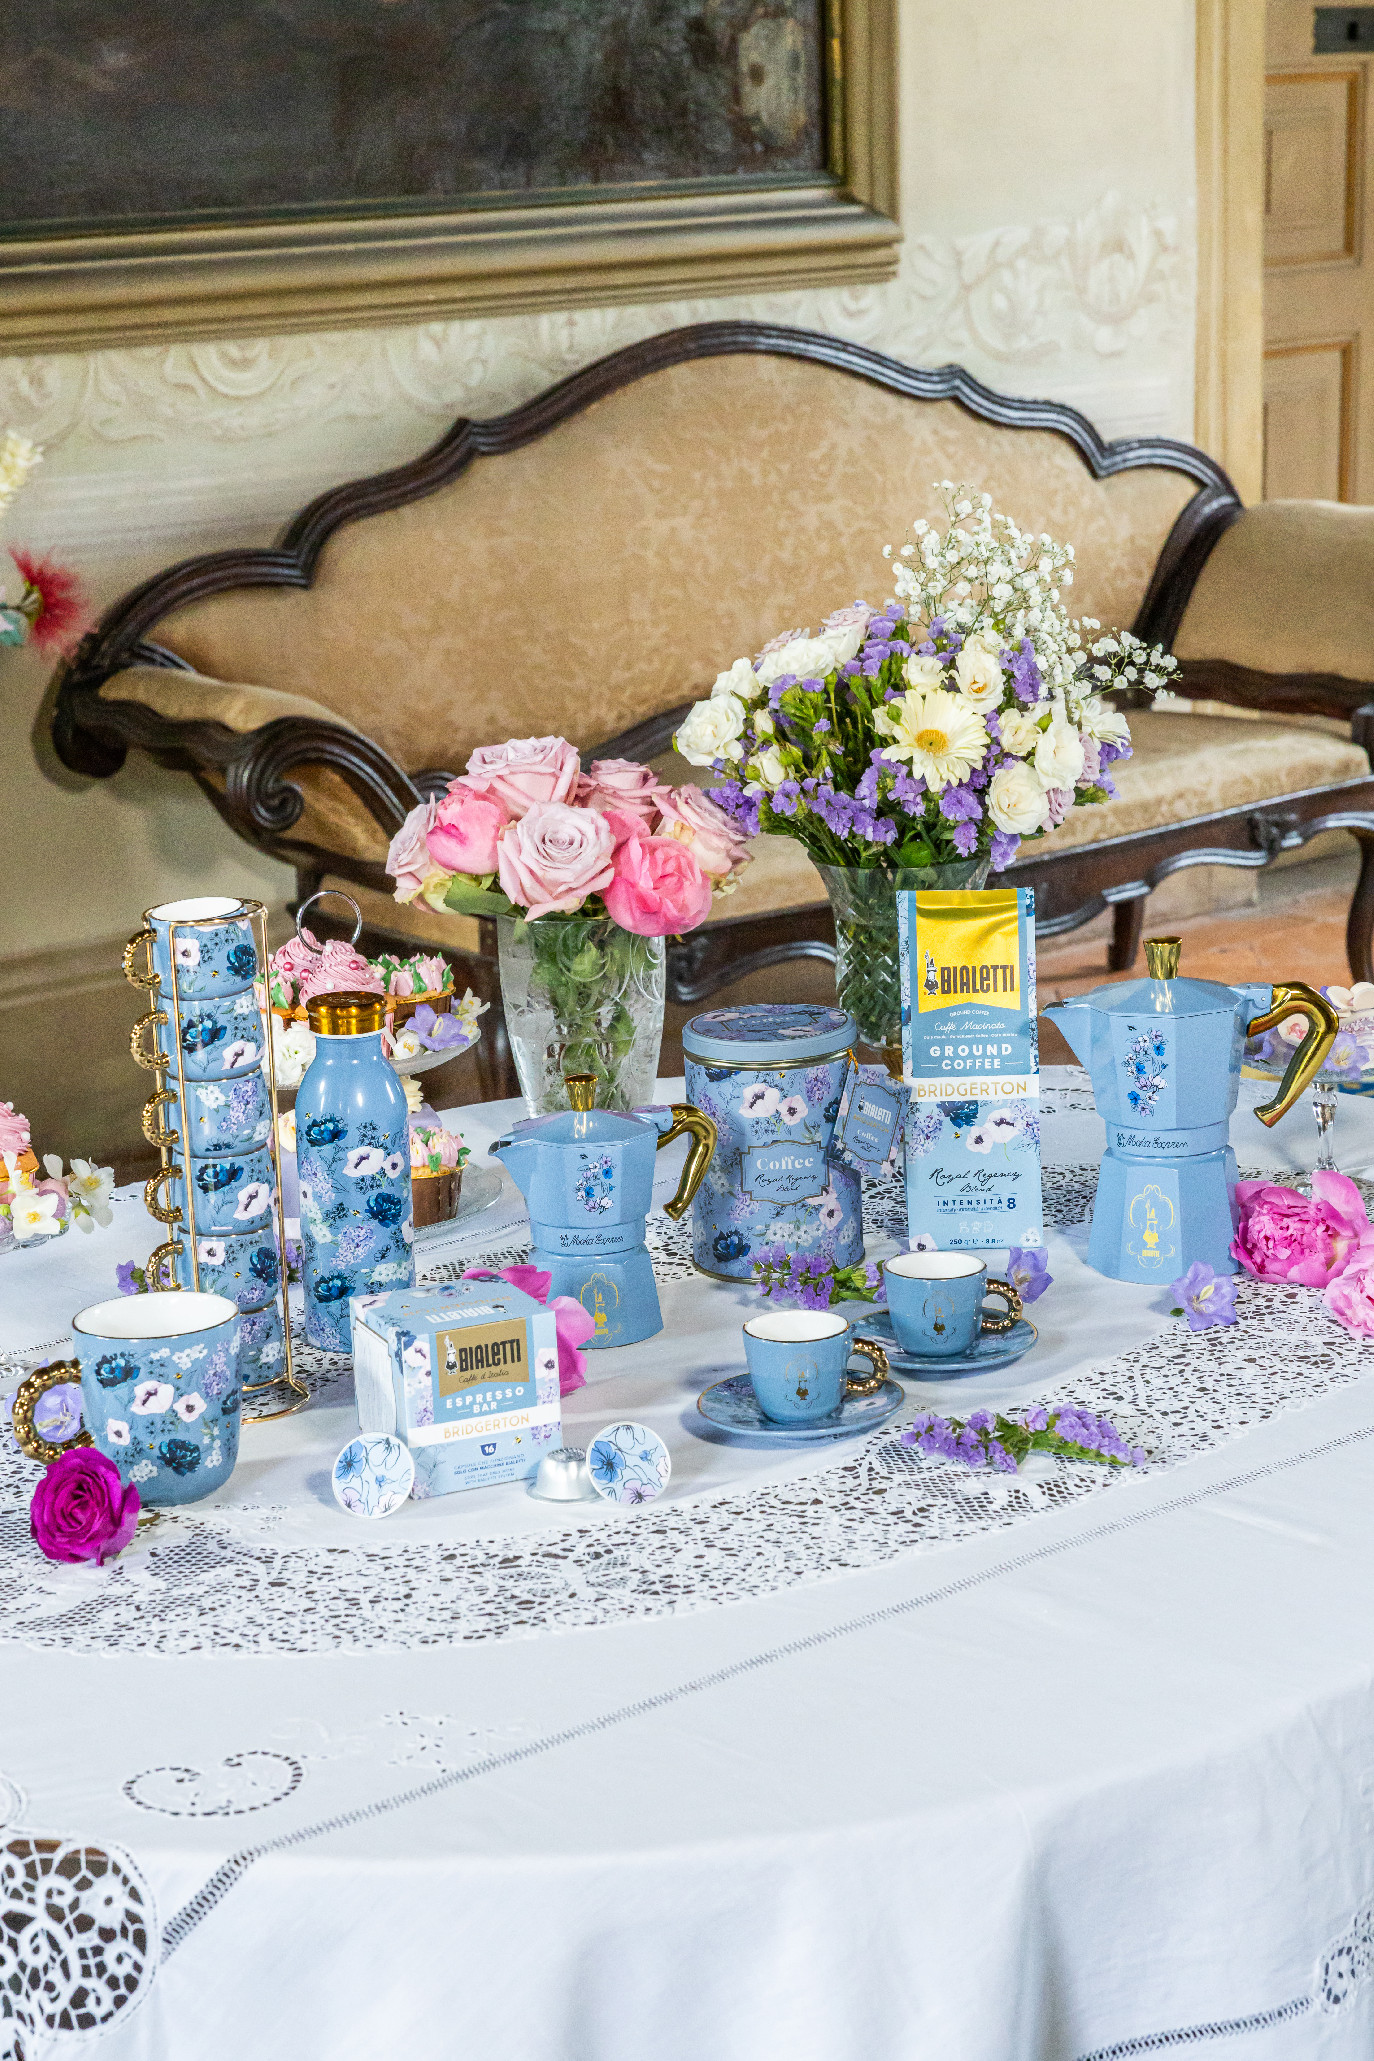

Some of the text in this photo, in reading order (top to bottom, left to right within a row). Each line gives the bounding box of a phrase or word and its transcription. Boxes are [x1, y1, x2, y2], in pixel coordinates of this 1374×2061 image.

[960, 1020, 1006, 1031] Macinato
[930, 1043, 1012, 1057] GROUND
[942, 1058, 1001, 1070] COFFEE
[917, 1081, 1027, 1098] BRIDGERTON
[756, 1156, 814, 1171] Coffee
[929, 1168, 1023, 1186] Royal Regency
[1006, 1198, 1016, 1210] 8
[446, 1386, 524, 1409] ESPRESSO
[473, 1402, 498, 1414] BAR
[444, 1413, 530, 1440] BRIDGERTON
[484, 1444, 494, 1454] 16
